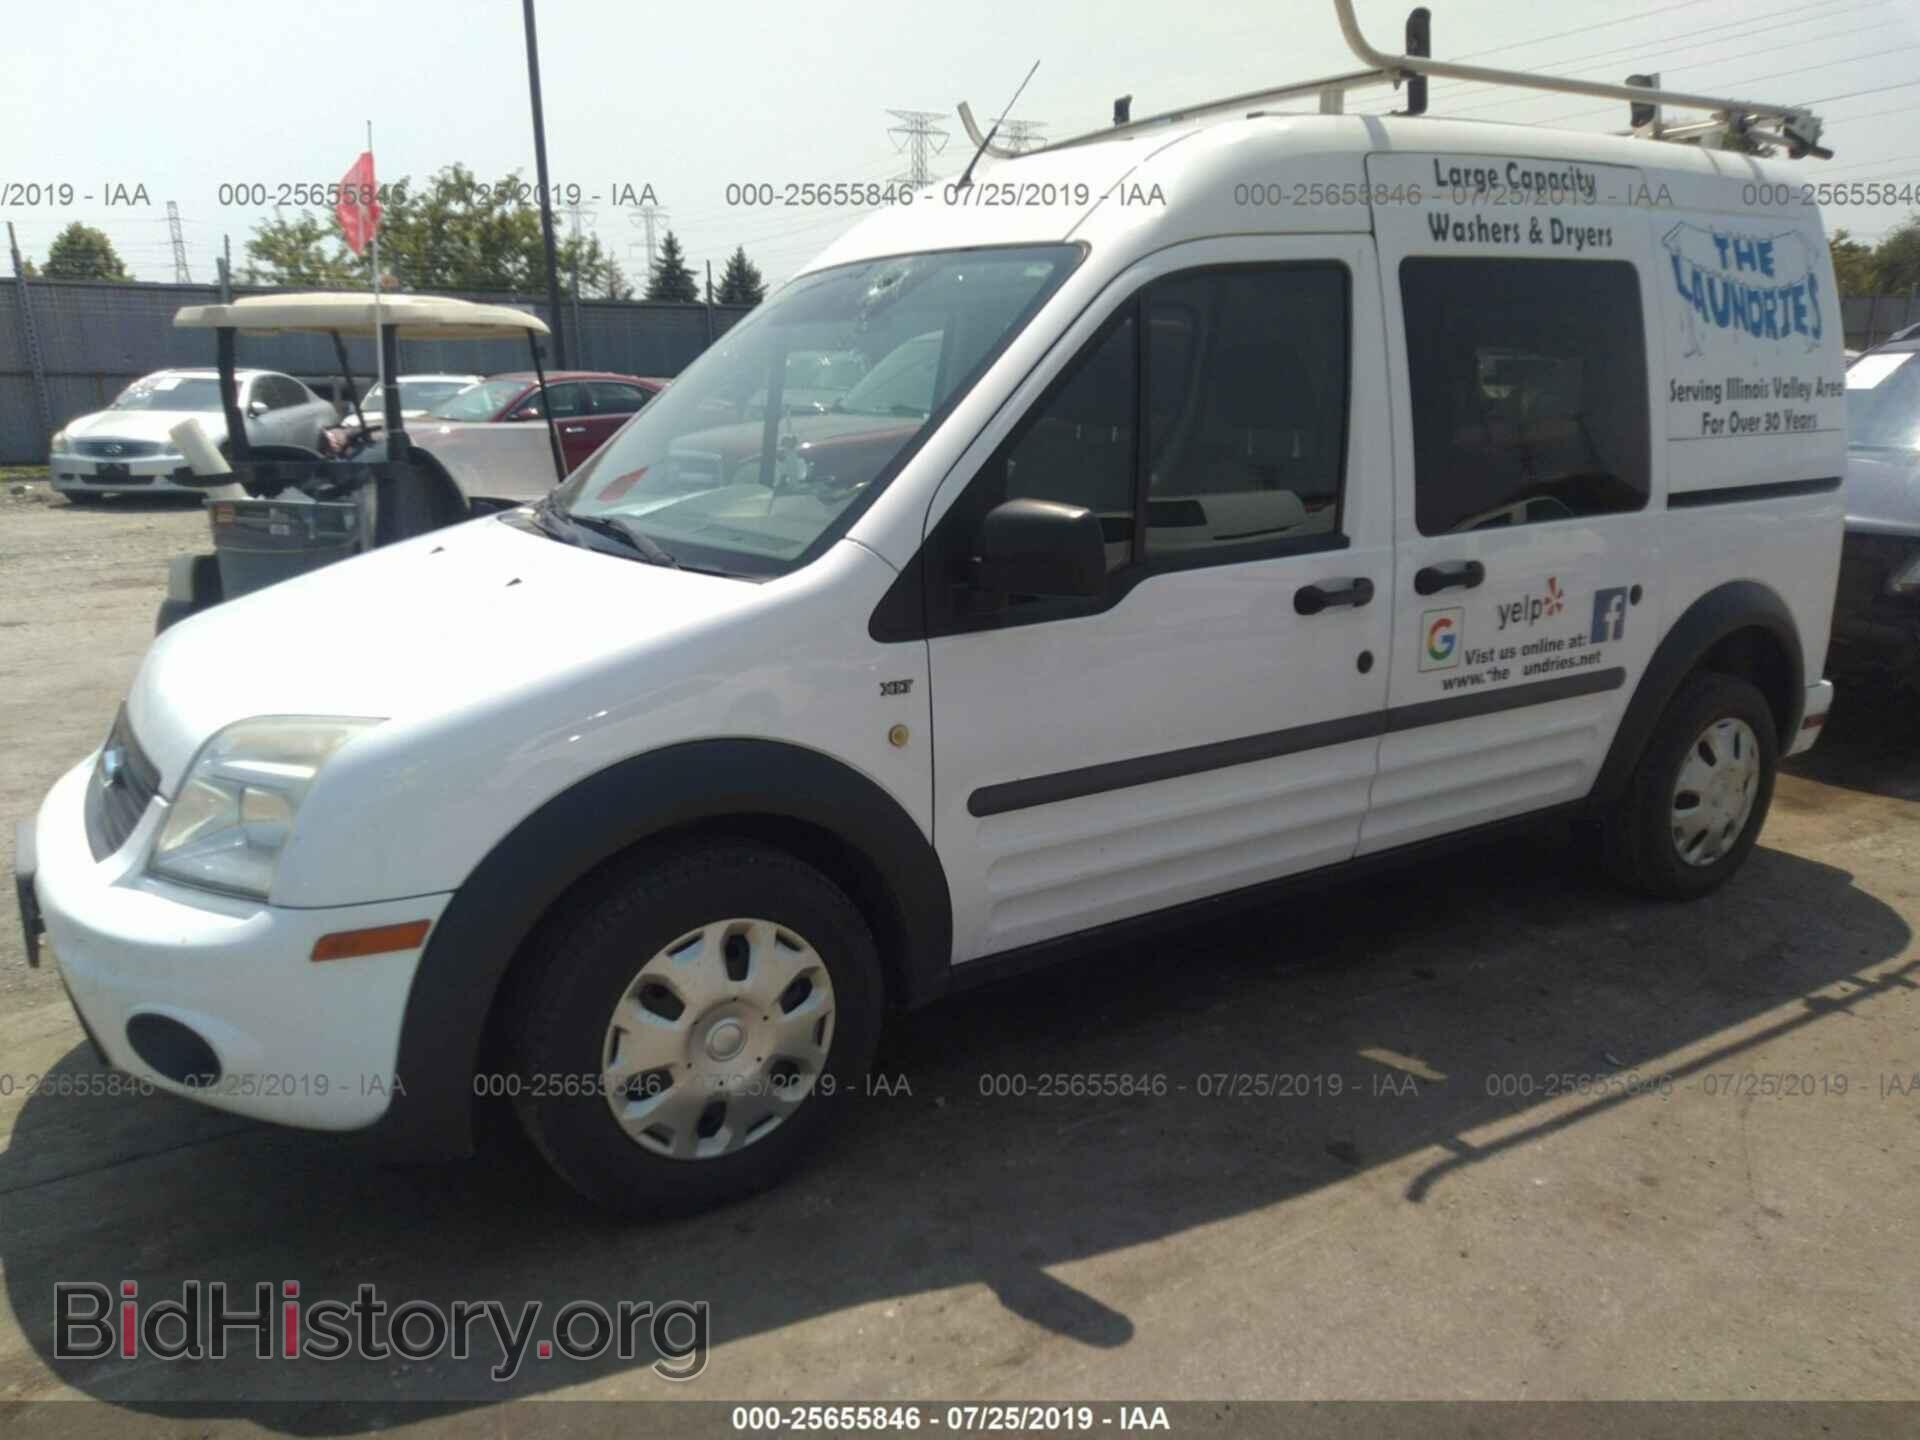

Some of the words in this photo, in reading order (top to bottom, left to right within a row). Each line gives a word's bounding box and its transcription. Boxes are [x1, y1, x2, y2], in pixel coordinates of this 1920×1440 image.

[1433, 158, 1499, 193] Large
[1505, 161, 1596, 197] Capacity
[1428, 212, 1520, 243] Washers
[1529, 216, 1543, 244] &
[1550, 217, 1613, 251] Dryers
[1713, 232, 1775, 278] THE
[1670, 254, 1822, 340] LAUNDRIES
[1669, 378, 1722, 404] Serving
[1726, 377, 1769, 400] Illinois
[1773, 376, 1812, 402] Valley
[1816, 376, 1845, 397] Area
[1702, 411, 1725, 435] For
[1729, 411, 1761, 433] Over
[1764, 411, 1781, 432] 30
[1784, 409, 1817, 430] Years
[1497, 595, 1542, 630] yelp
[1427, 618, 1456, 660] G
[1500, 646, 1516, 660] us
[1521, 638, 1564, 656] online
[1568, 633, 1587, 648] at:
